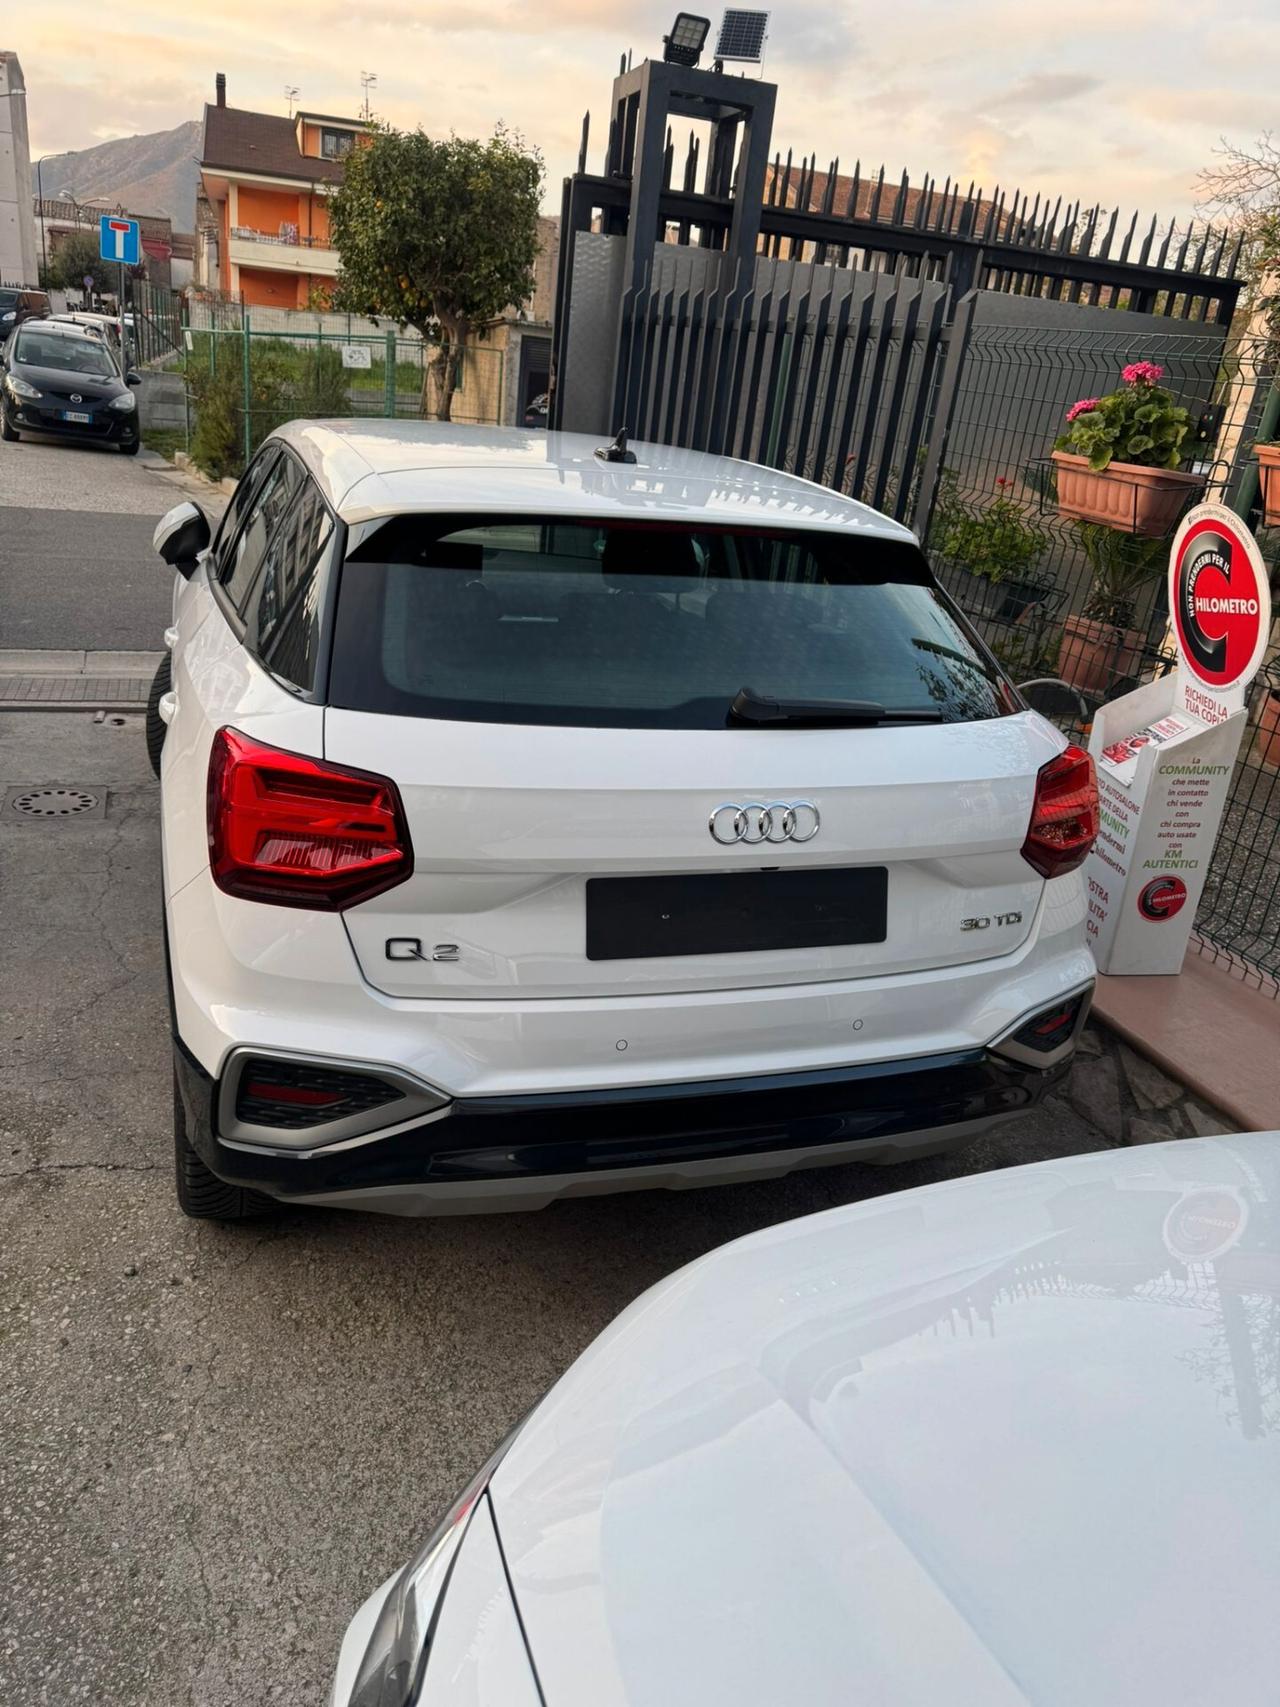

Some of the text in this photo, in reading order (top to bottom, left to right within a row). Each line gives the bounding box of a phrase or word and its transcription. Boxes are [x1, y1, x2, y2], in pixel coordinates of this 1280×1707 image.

[1212, 553, 1224, 567] PER
[1223, 562, 1230, 574] IL
[1185, 685, 1228, 718] RICHIEDI LA
[1185, 698, 1199, 716] TUA
[1158, 765, 1230, 775] COMMUNITY
[1105, 785, 1140, 815] AUTOSALONE
[1168, 788, 1176, 796] in
[1166, 799, 1178, 807] chi
[1112, 805, 1128, 822] DELLA
[1101, 809, 1130, 839] MUNITY
[1160, 820, 1201, 829] chi compra
[1093, 841, 1126, 877] hilometro
[1164, 850, 1182, 859] KM
[1142, 860, 1199, 869] AUTENTICI
[960, 917, 990, 931] 30
[385, 937, 460, 961] Q2
